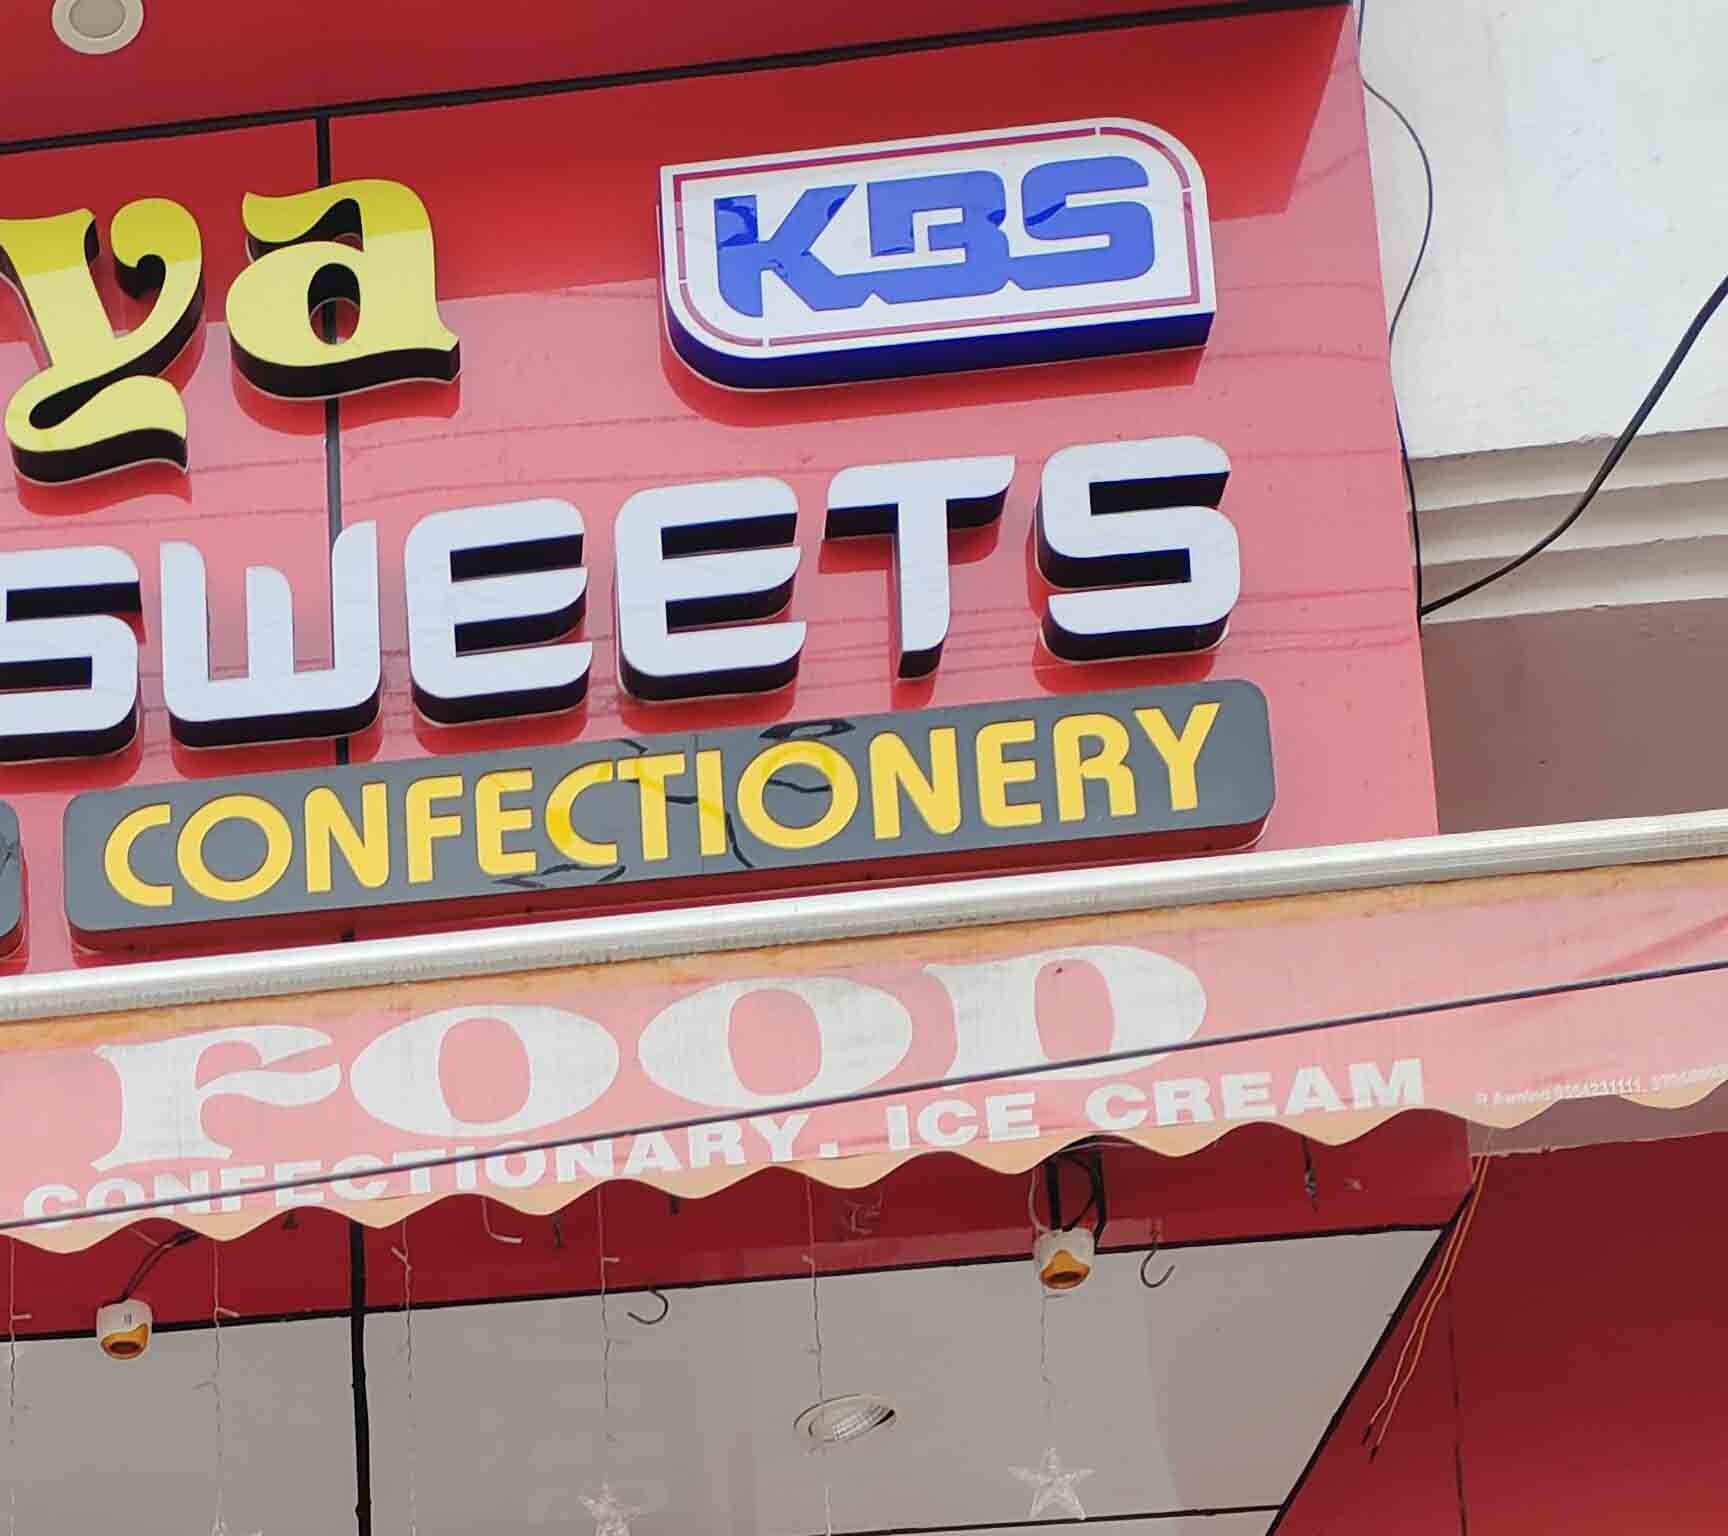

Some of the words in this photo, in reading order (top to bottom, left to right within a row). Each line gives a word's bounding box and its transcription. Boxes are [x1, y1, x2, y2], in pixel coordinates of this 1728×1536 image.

[713, 155, 1156, 318] KBS
[103, 703, 1221, 907] CONFECTIONERY
[92, 945, 1207, 1172] FOOD
[885, 1092, 1040, 1152] ICE
[1085, 1058, 1425, 1131] CREAM
